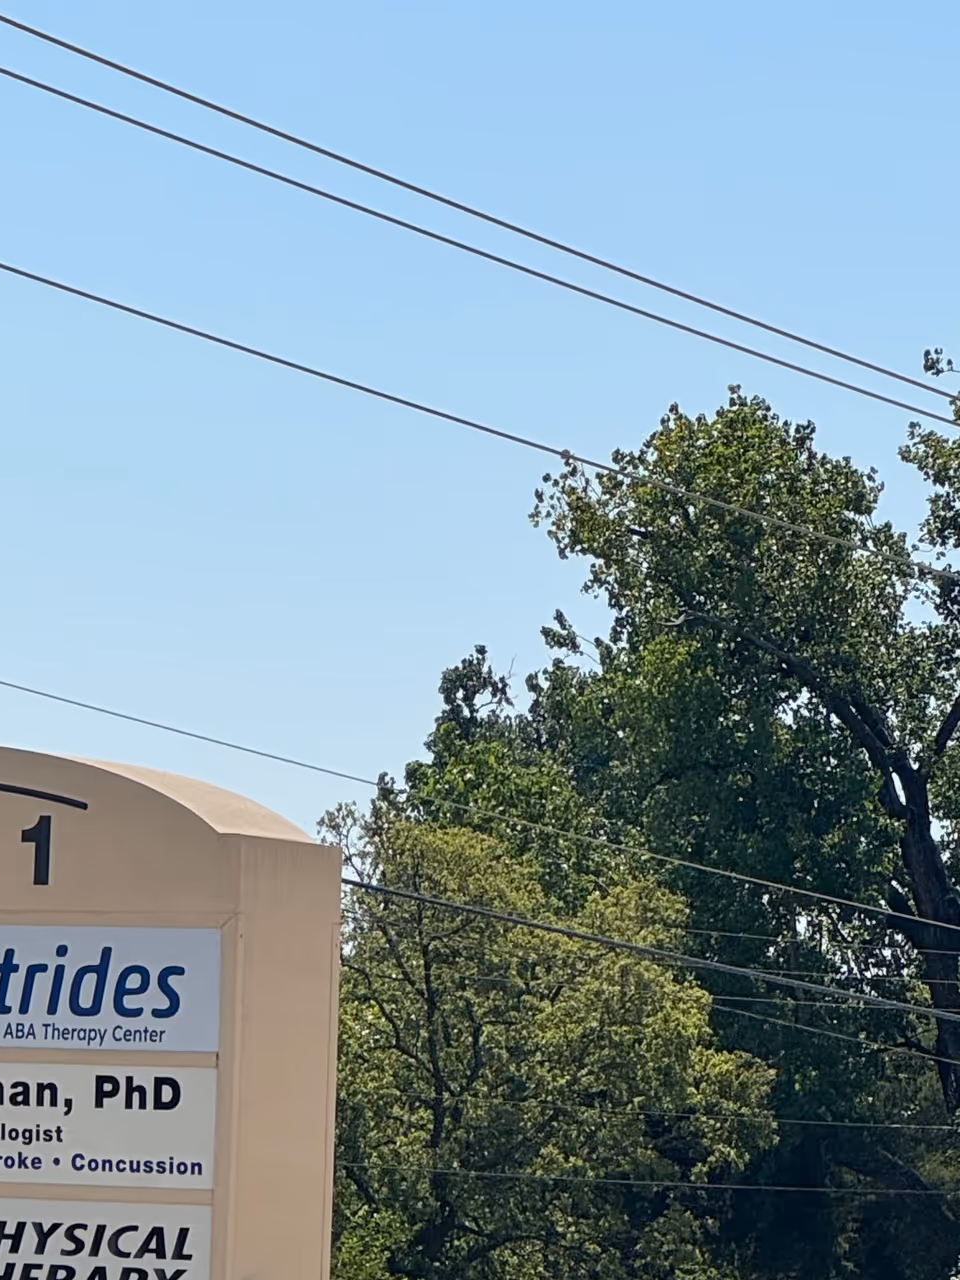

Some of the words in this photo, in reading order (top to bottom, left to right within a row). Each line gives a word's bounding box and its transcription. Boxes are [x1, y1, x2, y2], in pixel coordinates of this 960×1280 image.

[3, 1023, 37, 1040] ABA
[42, 1023, 108, 1047] Therapy
[112, 1025, 166, 1043] Center
[94, 1074, 182, 1111] PhD
[71, 1153, 203, 1176] Concussion
